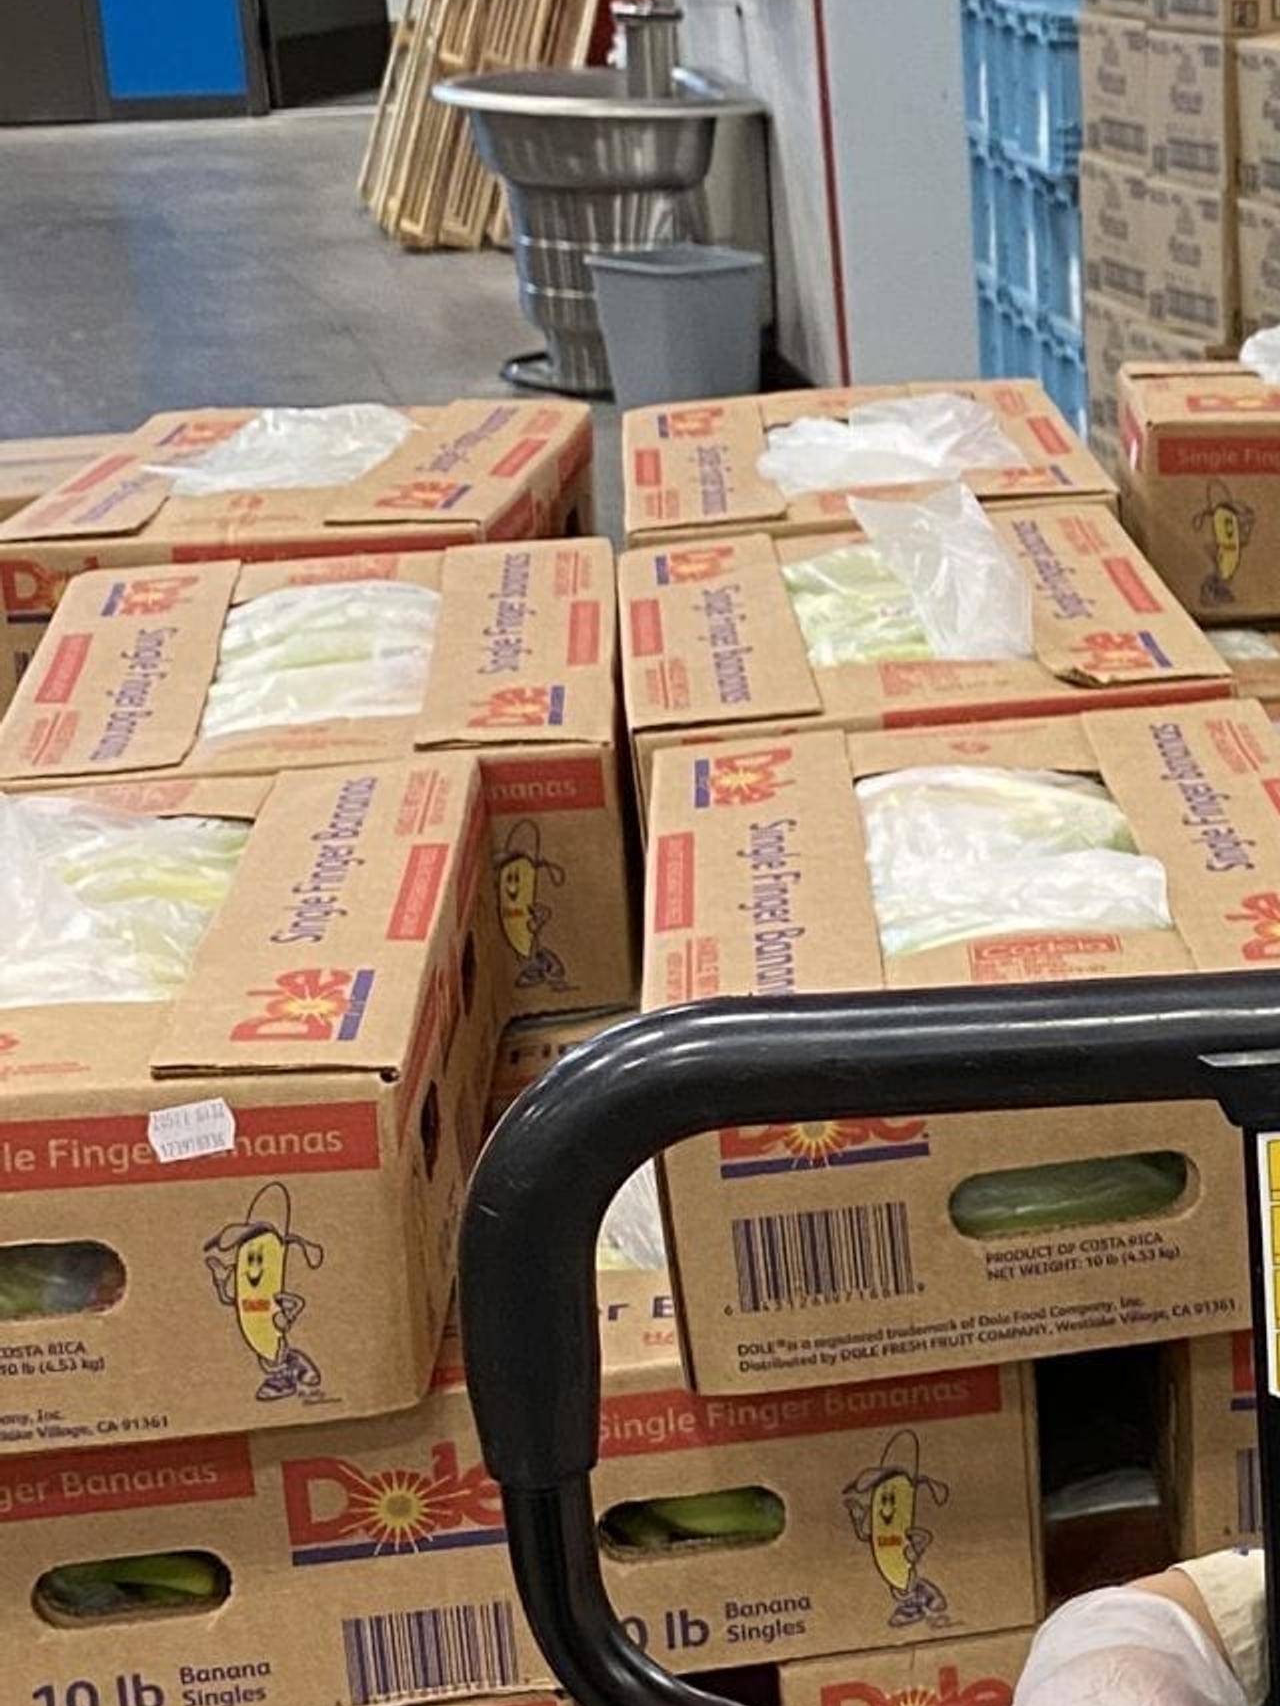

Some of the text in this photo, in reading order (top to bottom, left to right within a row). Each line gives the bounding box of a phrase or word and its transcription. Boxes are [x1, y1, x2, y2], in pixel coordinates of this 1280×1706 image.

[310, 776, 378, 841] Bananas
[292, 844, 366, 894] Finger
[737, 818, 802, 925] Single Finger
[270, 895, 348, 944] Single
[48, 1134, 157, 1175] Finge
[985, 1232, 1163, 1265] PRODUCT OF COSTA RICA
[987, 1263, 1015, 1282] NET
[1019, 1256, 1084, 1277] WEIGHT:
[1086, 1254, 1103, 1268] 10
[1106, 1252, 1119, 1265] lb
[1158, 1245, 1181, 1261] kg)
[819, 1352, 837, 1365] by
[841, 1344, 879, 1359] DOLE
[1172, 1304, 1192, 1317] CA
[1013, 1308, 1047, 1322] Food
[599, 1377, 972, 1443] Single Finger Bananas
[62, 1461, 219, 1497] Bananas
[281, 1441, 503, 1549] Dole
[665, 1592, 812, 1650] lb Banana
[726, 1617, 807, 1643] Singles
[179, 1659, 272, 1686] Banana
